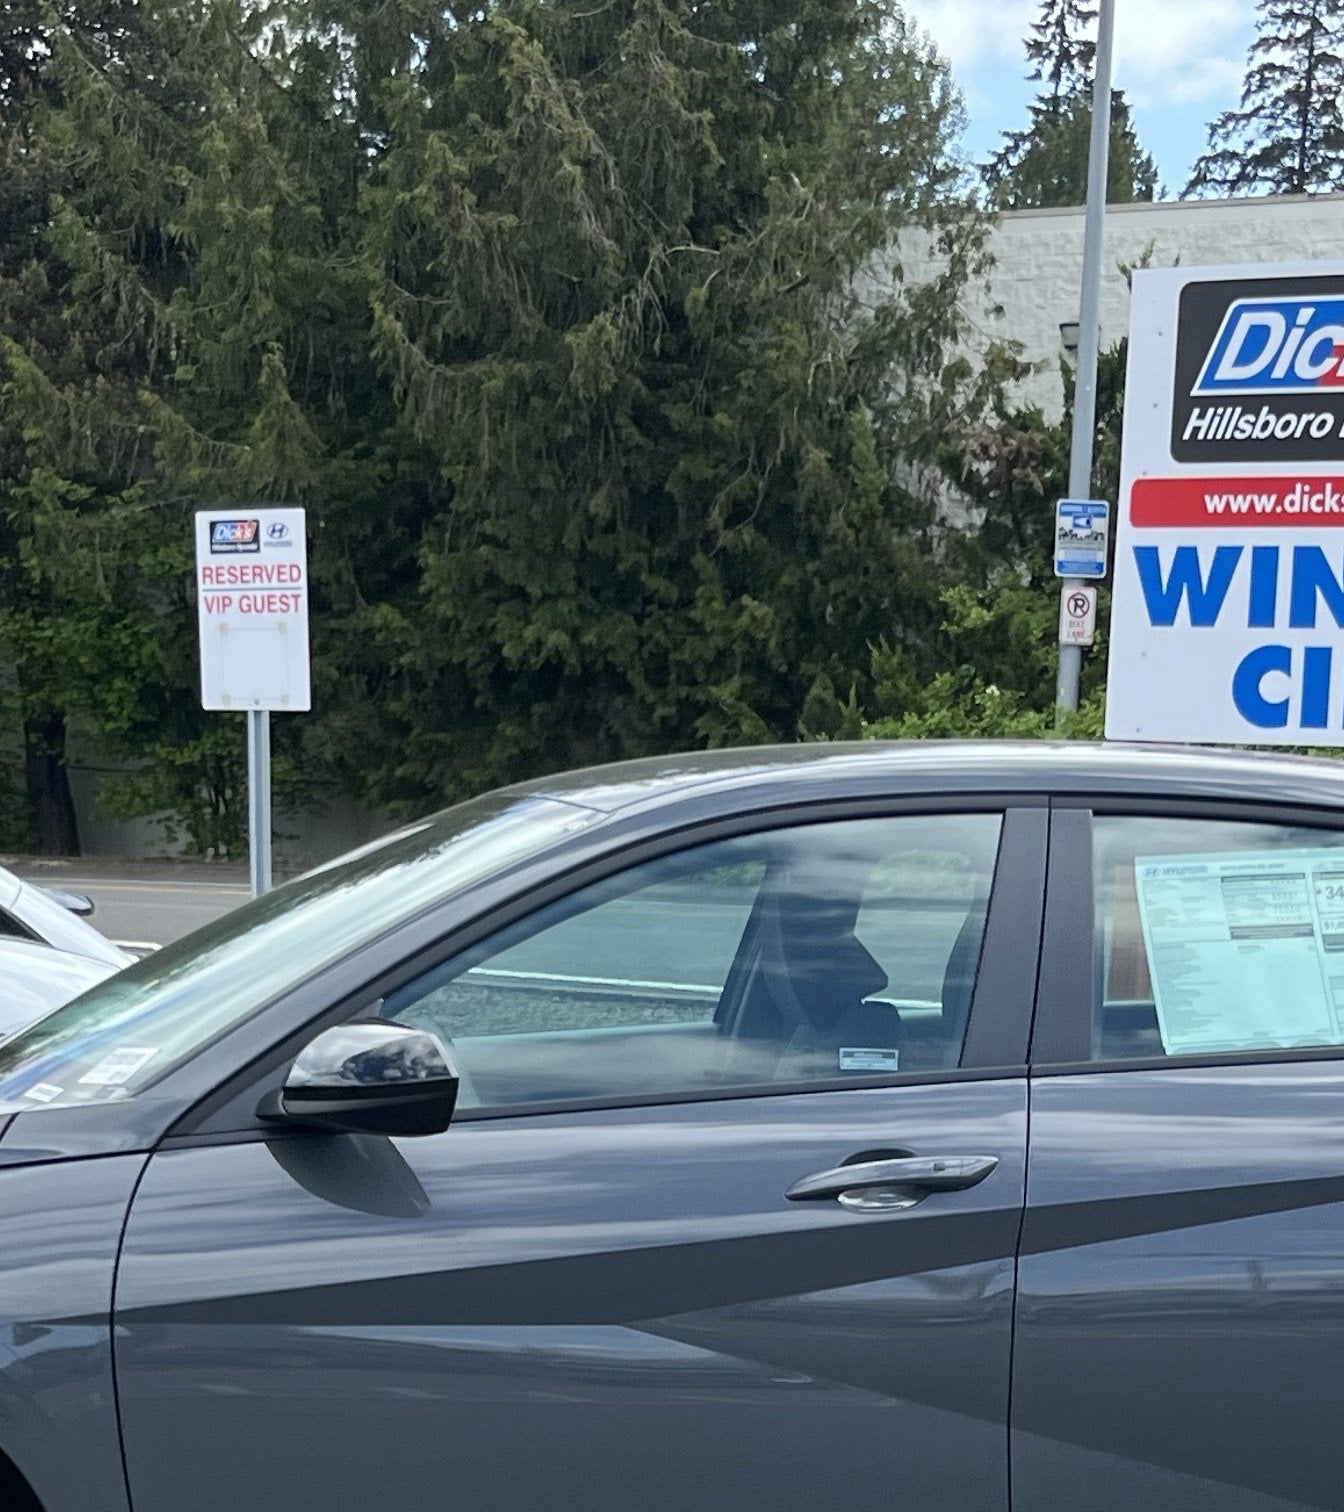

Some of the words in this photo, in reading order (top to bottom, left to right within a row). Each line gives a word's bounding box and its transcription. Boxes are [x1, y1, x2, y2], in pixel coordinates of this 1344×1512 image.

[1182, 405, 1335, 441] Hillsboro
[202, 564, 302, 585] RESERVED
[204, 595, 233, 614] VIP
[238, 594, 302, 614] GUEST
